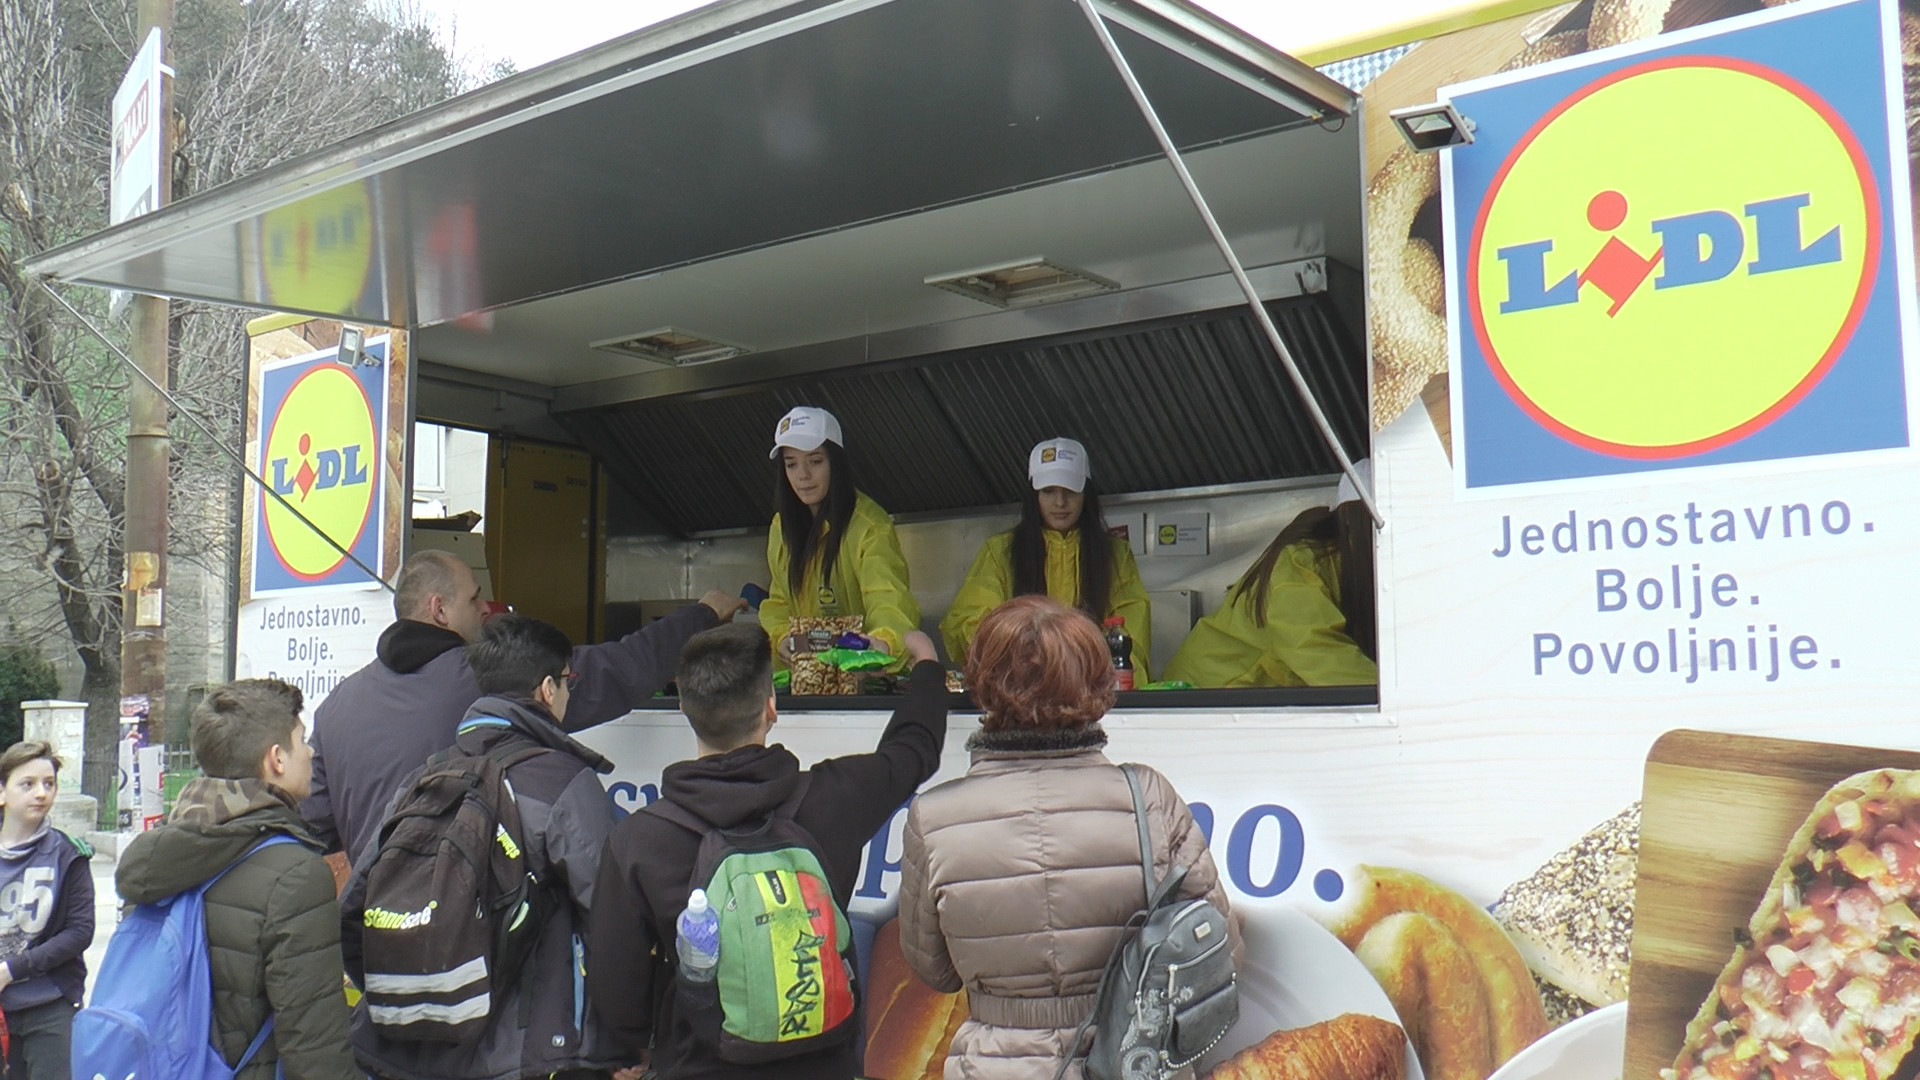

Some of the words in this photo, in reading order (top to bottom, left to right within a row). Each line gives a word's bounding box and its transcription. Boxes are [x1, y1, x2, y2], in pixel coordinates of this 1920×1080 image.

[1492, 500, 1875, 558] Jednostavno.
[260, 604, 366, 630] Jednostavno.
[1596, 563, 1760, 619] Bolje.
[287, 636, 334, 666] Bolje.
[1532, 624, 1841, 683] Povoljnije.
[0, 866, 55, 934] 95
